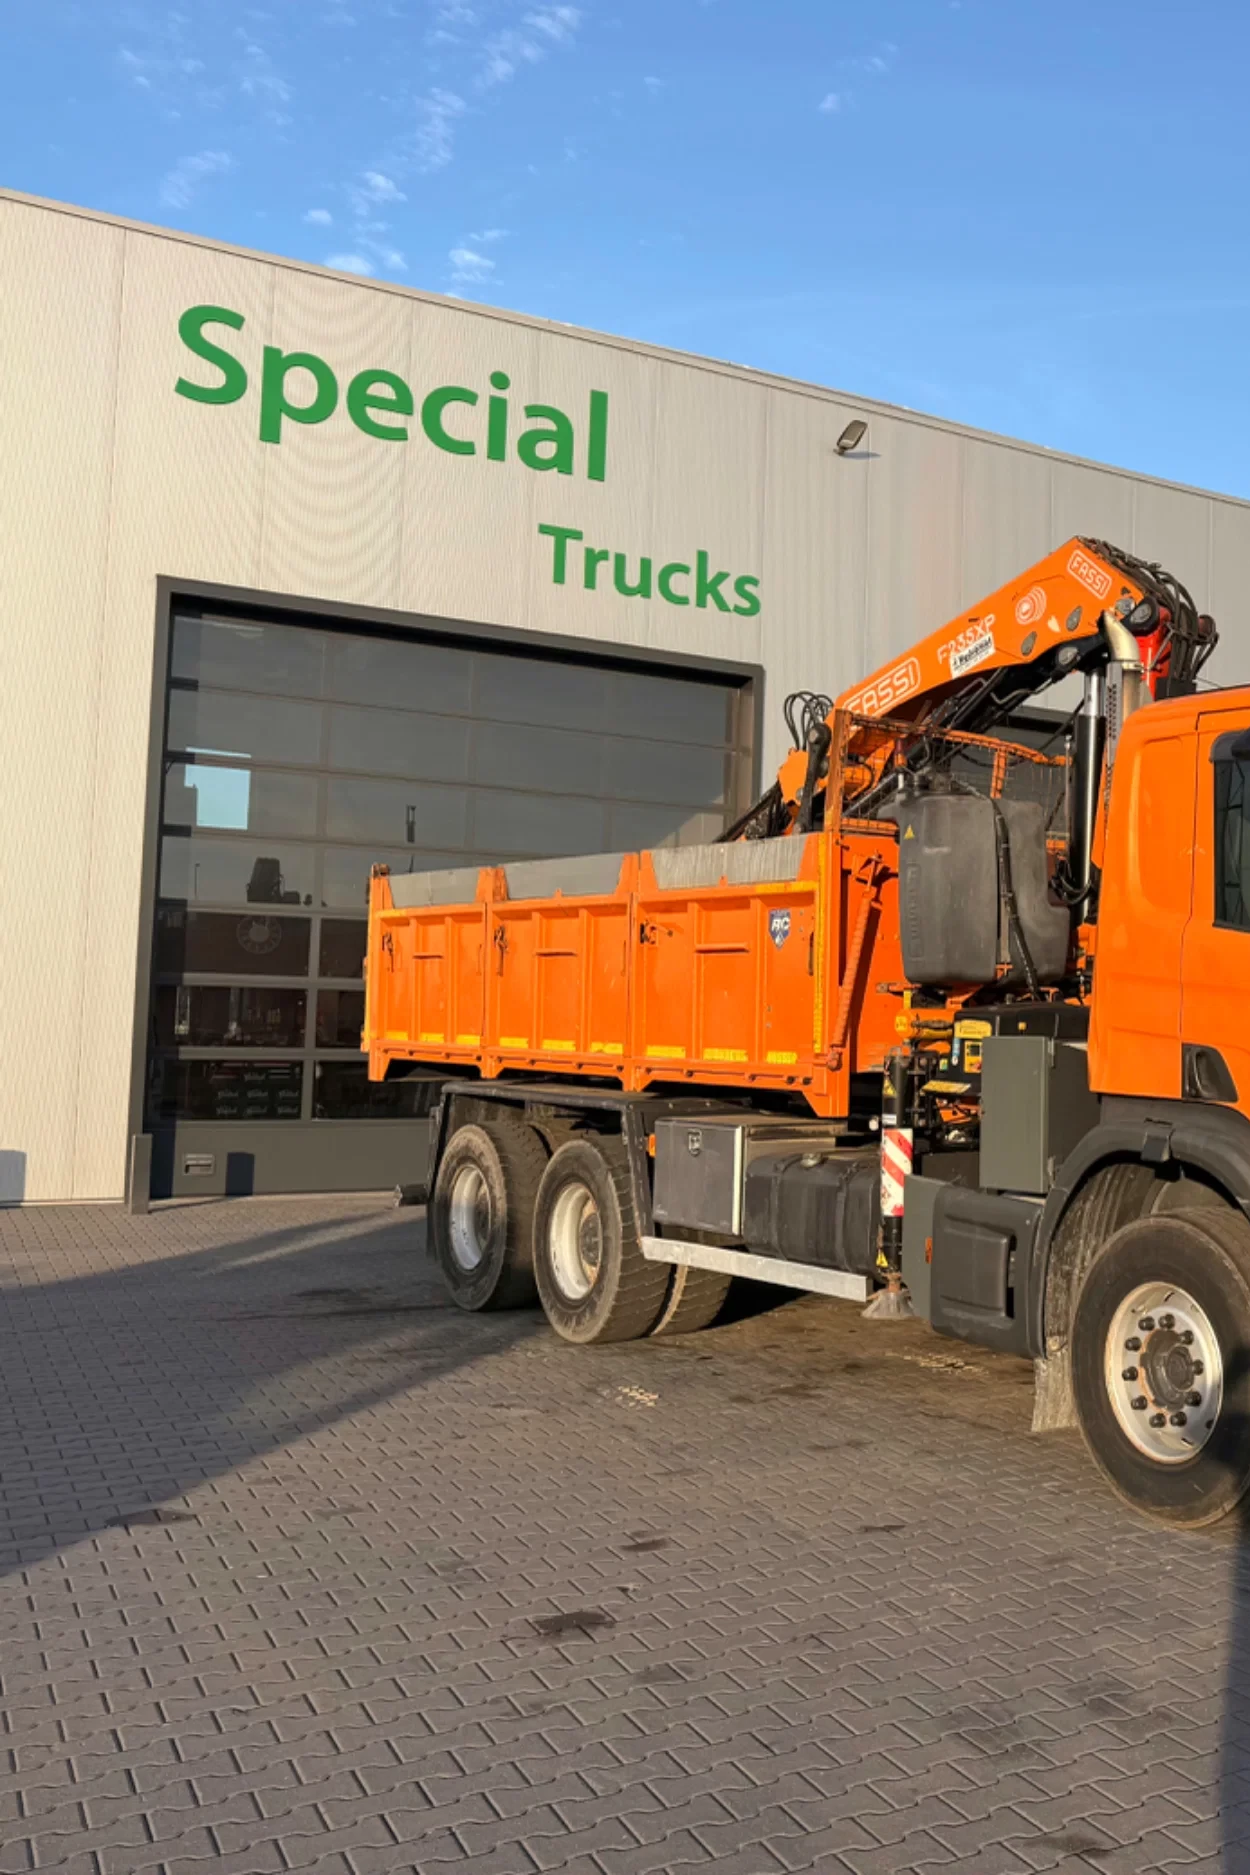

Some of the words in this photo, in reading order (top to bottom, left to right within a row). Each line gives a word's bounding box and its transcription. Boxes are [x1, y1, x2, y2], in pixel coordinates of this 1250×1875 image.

[175, 305, 608, 482] Special
[538, 523, 761, 617] Trucks
[1071, 556, 1108, 594] FASSI
[847, 663, 915, 715] FASSI
